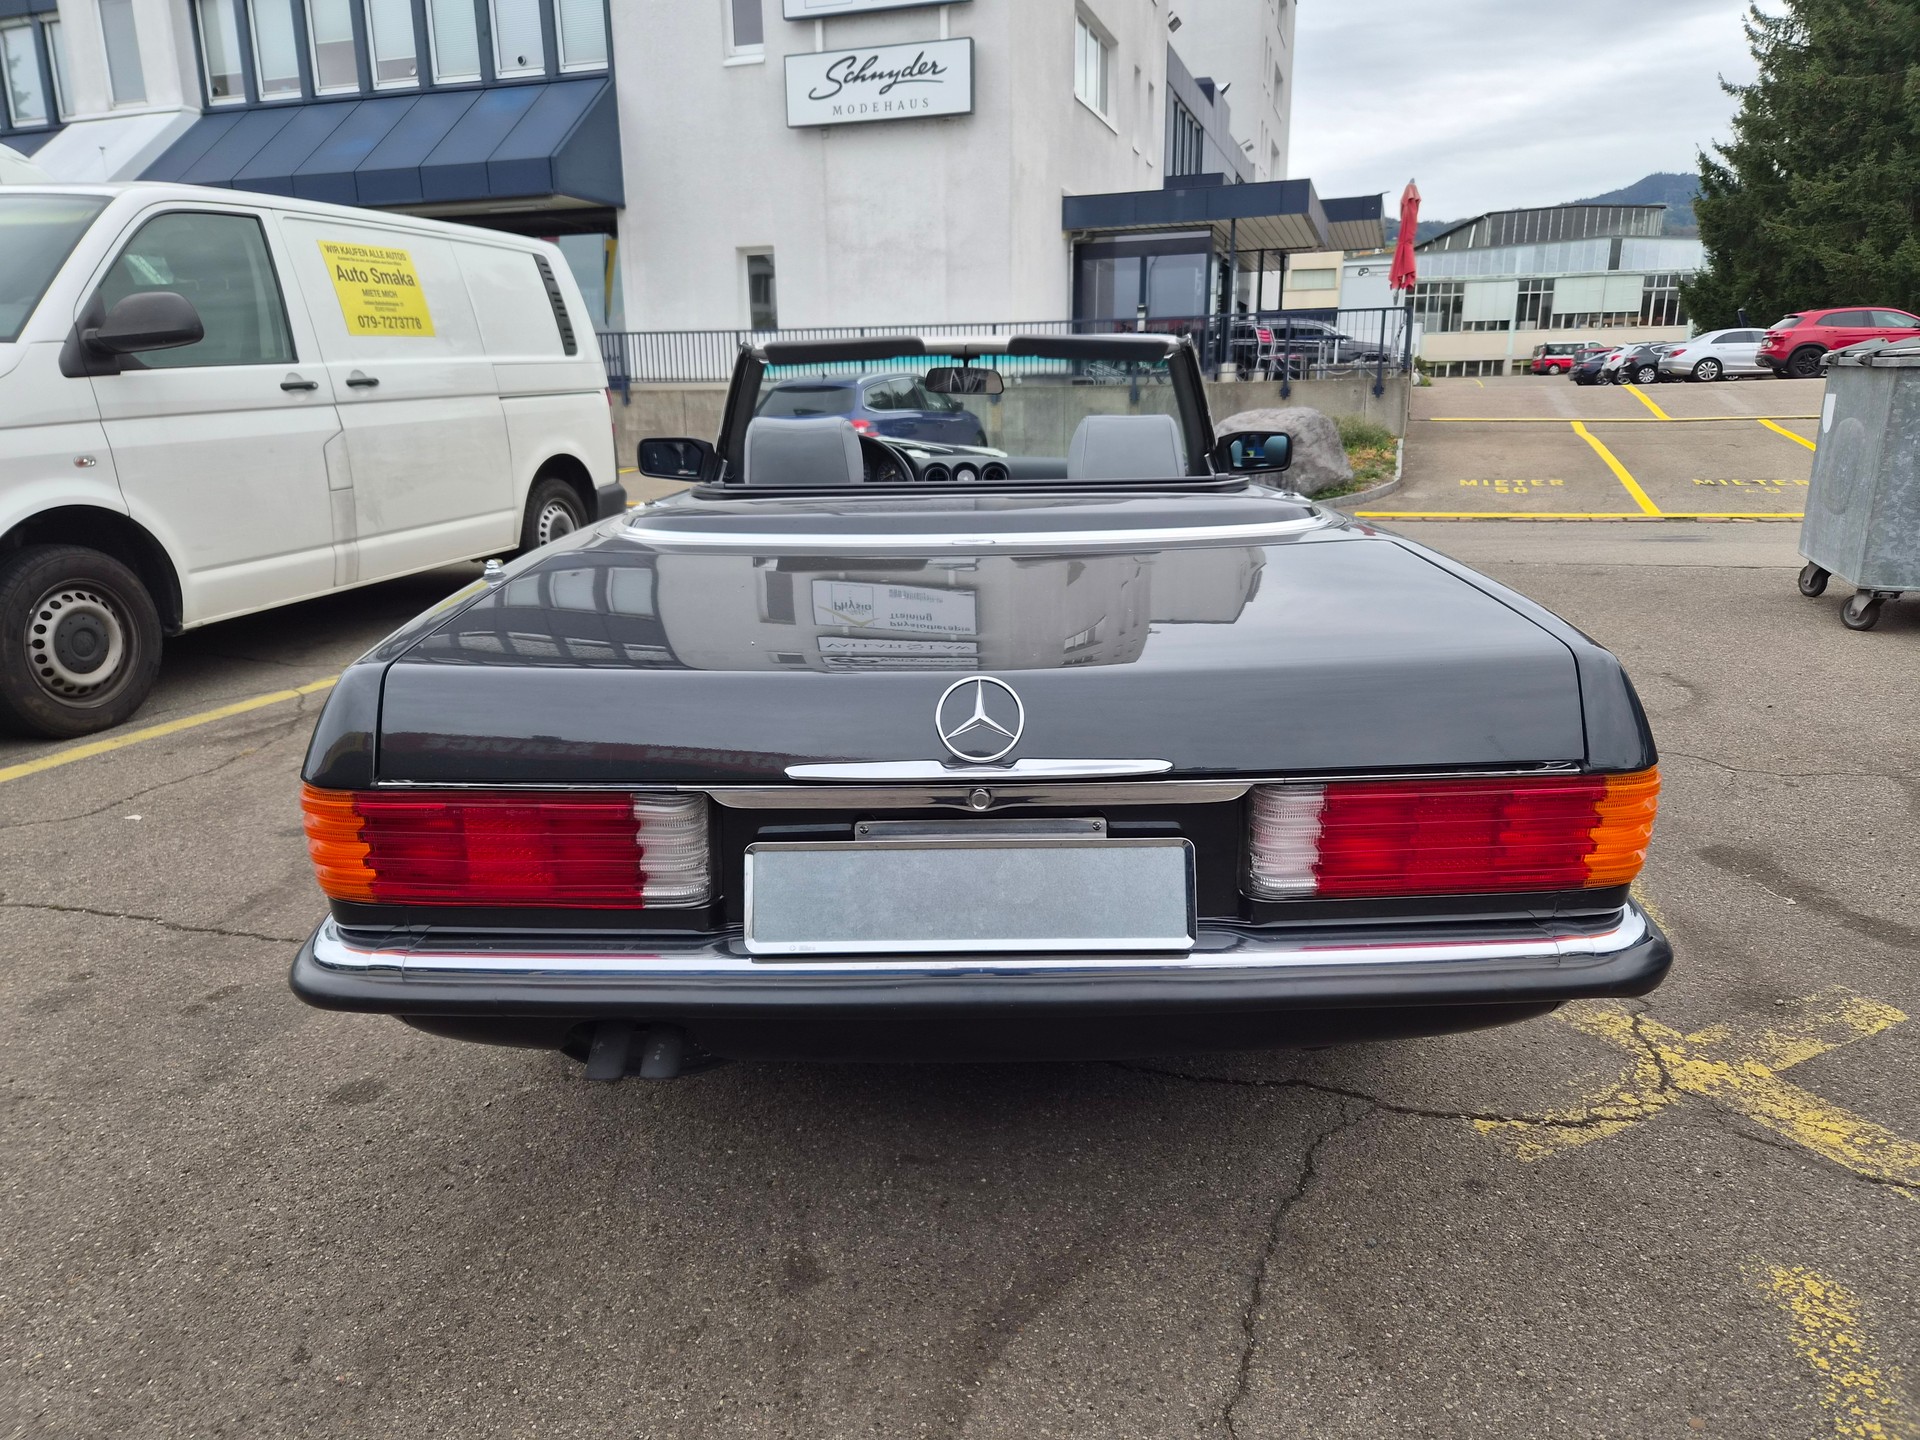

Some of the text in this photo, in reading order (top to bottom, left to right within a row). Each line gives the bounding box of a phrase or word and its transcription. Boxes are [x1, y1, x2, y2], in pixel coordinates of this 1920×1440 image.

[808, 50, 948, 101] Schnyder
[832, 97, 931, 116] MODEHAUS
[324, 244, 339, 255] WIR
[340, 245, 368, 257] KAUFEN
[369, 249, 385, 259] ALLE
[386, 251, 406, 261] AUTOS
[336, 264, 416, 287] Auto Smaka
[362, 288, 398, 298] MIETE MICH
[357, 315, 422, 330] 079-7273778
[1459, 479, 1565, 487] MIETER
